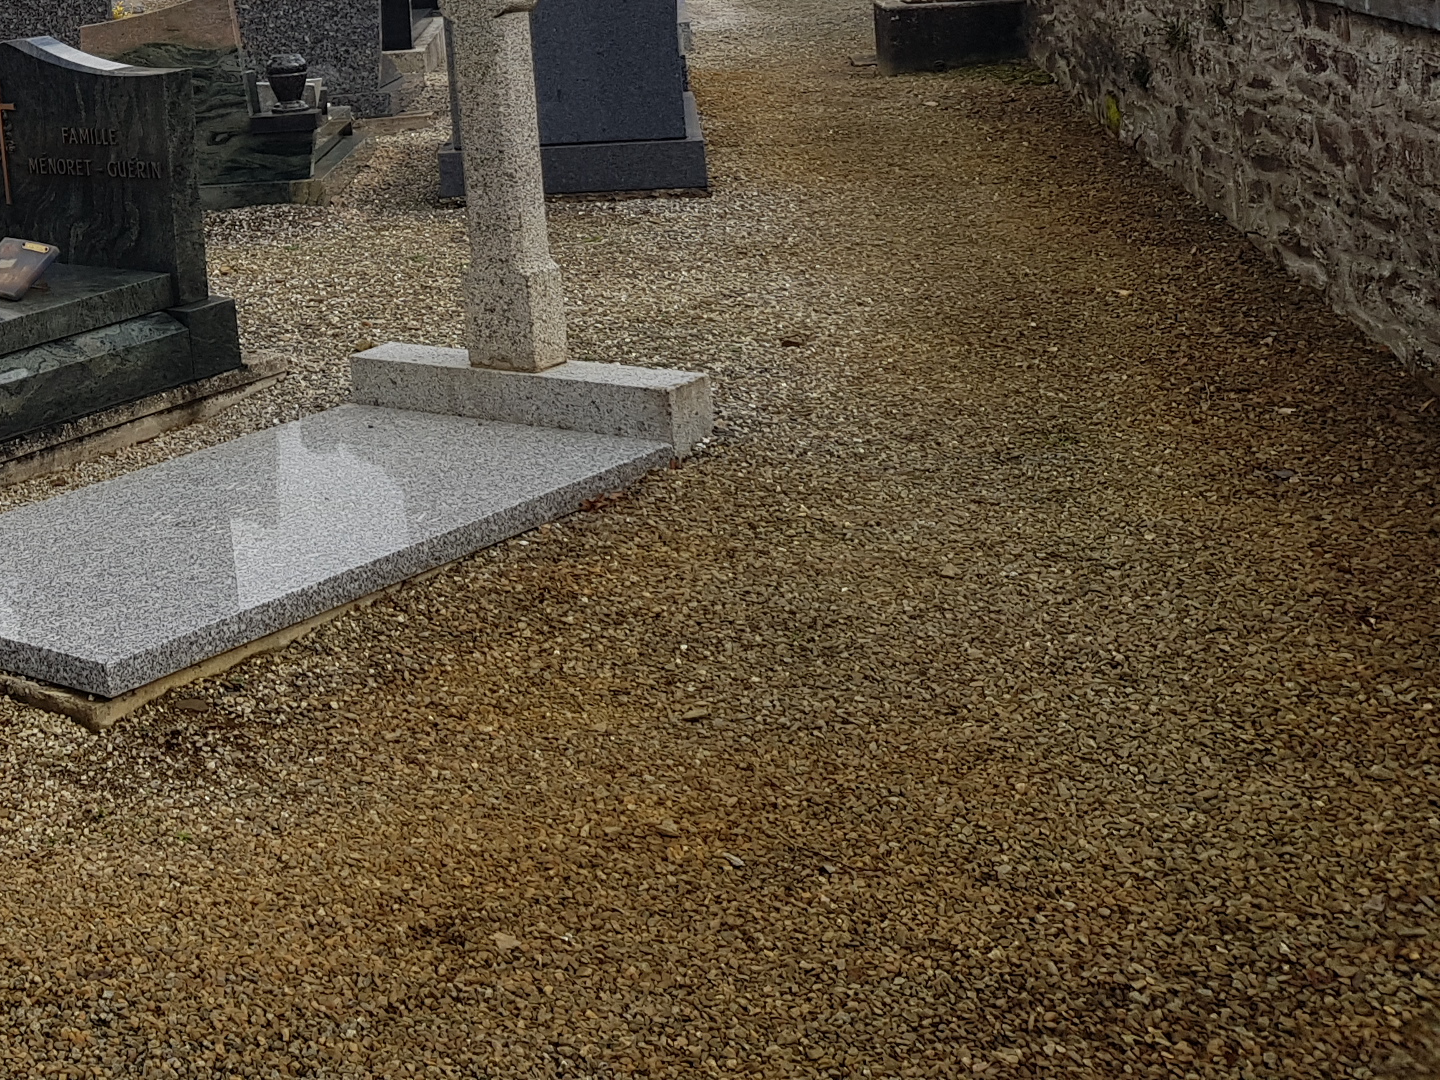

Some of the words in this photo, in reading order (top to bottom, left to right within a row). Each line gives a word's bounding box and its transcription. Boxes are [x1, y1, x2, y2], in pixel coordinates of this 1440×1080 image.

[61, 126, 119, 146] FAMILLE
[28, 152, 92, 177] MÉNORET
[107, 156, 162, 179] GUÉRIN
